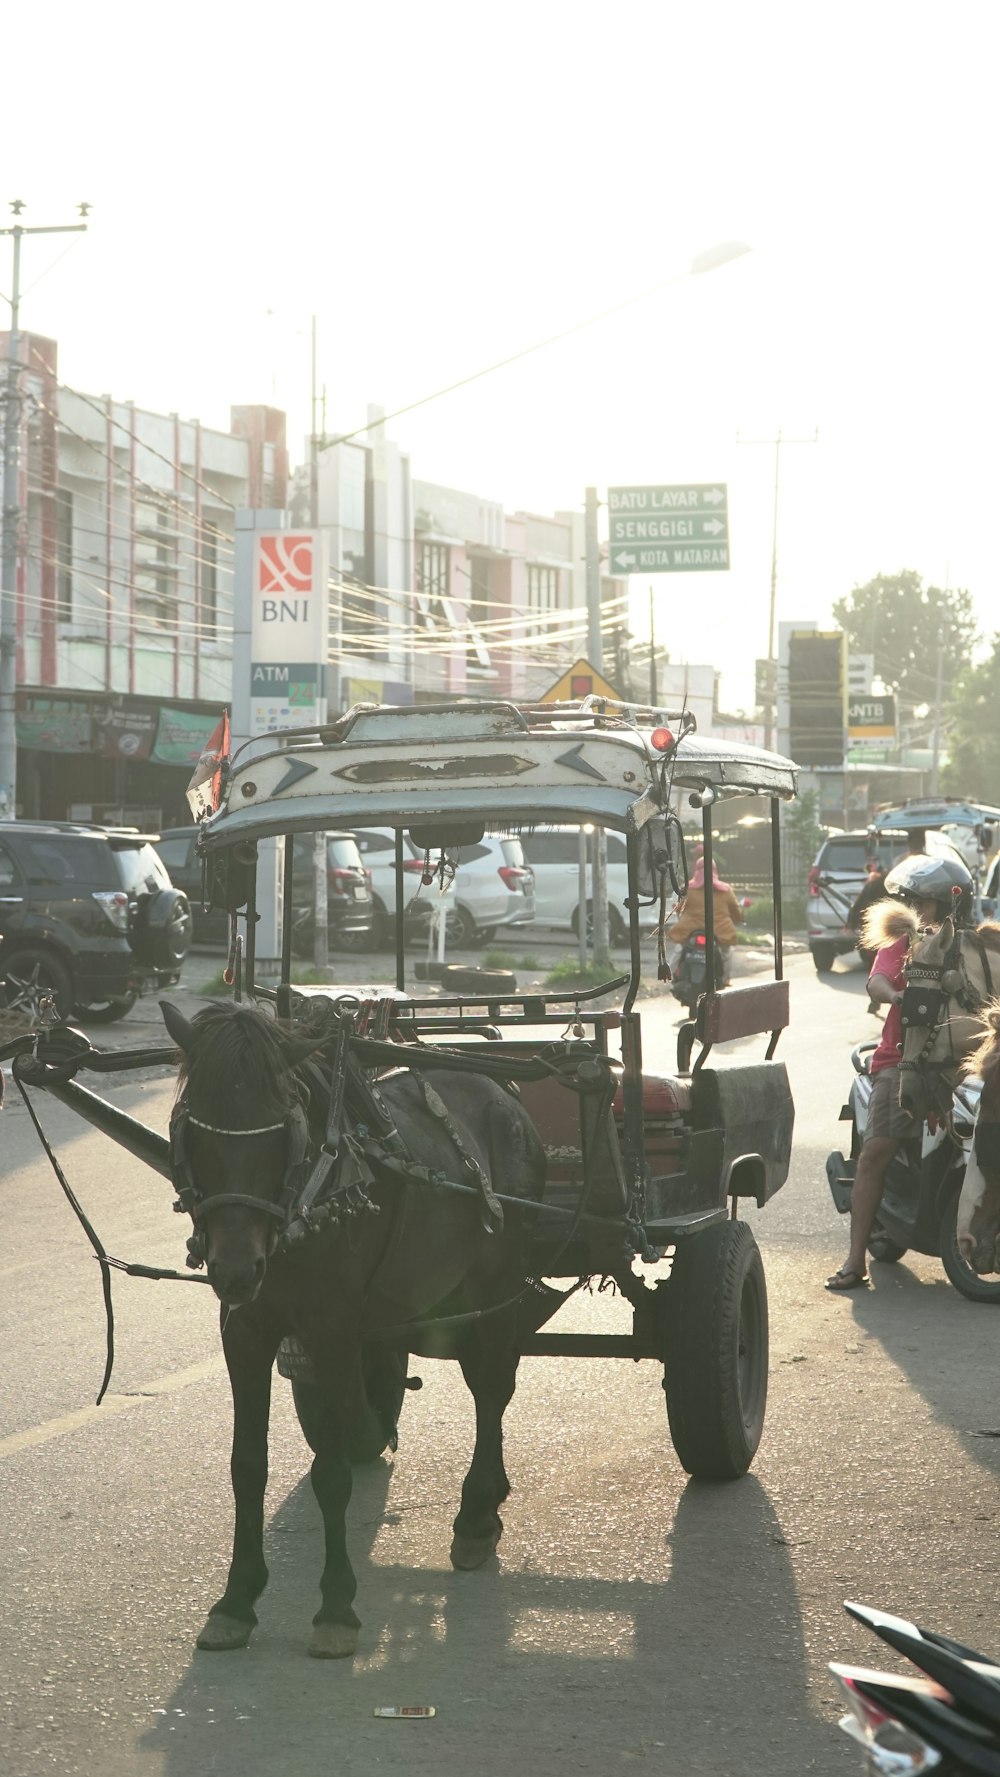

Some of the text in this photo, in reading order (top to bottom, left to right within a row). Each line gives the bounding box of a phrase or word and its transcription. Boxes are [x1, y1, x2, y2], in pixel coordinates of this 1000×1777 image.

[609, 491, 697, 509] BATU LAYAR
[615, 520, 693, 538] SENGGIGI
[641, 551, 668, 565] KOTA
[262, 600, 308, 622] BNI
[253, 667, 289, 681] ATM
[289, 683, 313, 703] 24
